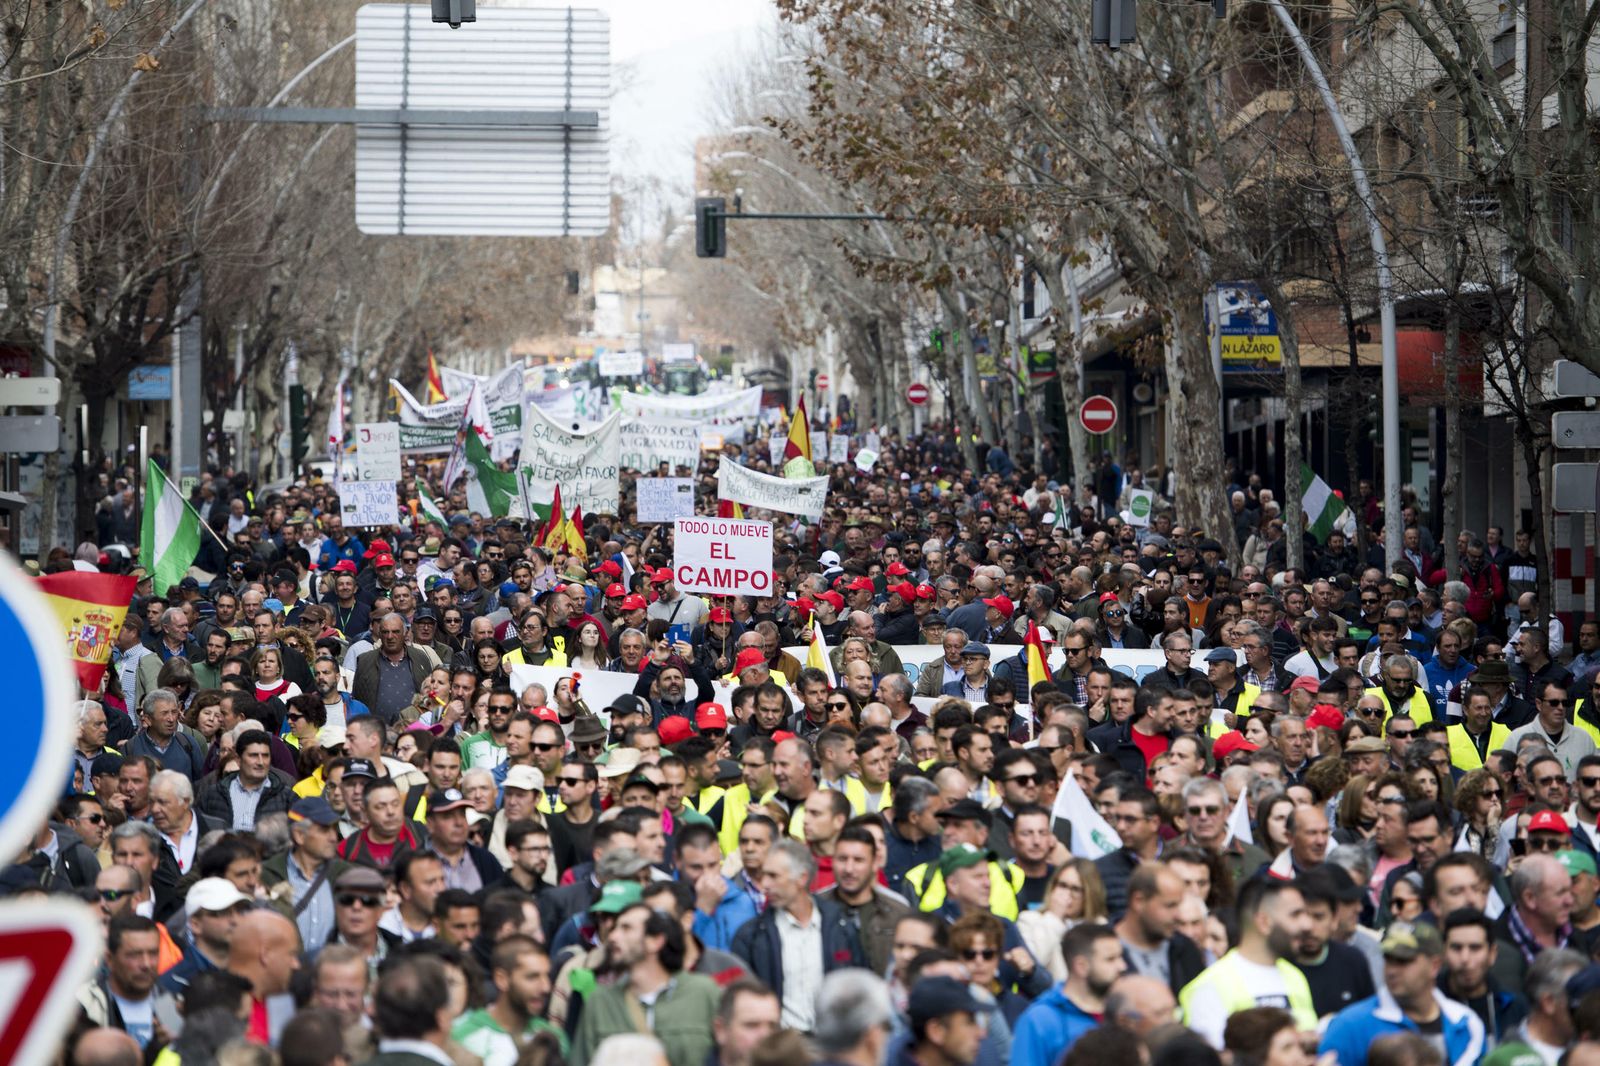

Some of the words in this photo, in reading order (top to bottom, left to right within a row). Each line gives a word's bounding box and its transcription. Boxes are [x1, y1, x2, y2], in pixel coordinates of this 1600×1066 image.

[1233, 340, 1275, 354] LÁZARO
[533, 423, 573, 448] SALAR
[536, 447, 586, 470] PUEBLO
[586, 465, 617, 479] FAVOR
[640, 479, 675, 490] SALAR
[365, 493, 395, 505] FAVOR
[351, 512, 391, 526] OLIVAR
[679, 520, 709, 534] TODO
[712, 523, 728, 536] LO
[730, 524, 769, 538] MUEVE
[710, 542, 736, 560] EL
[677, 565, 769, 591] CAMPO
